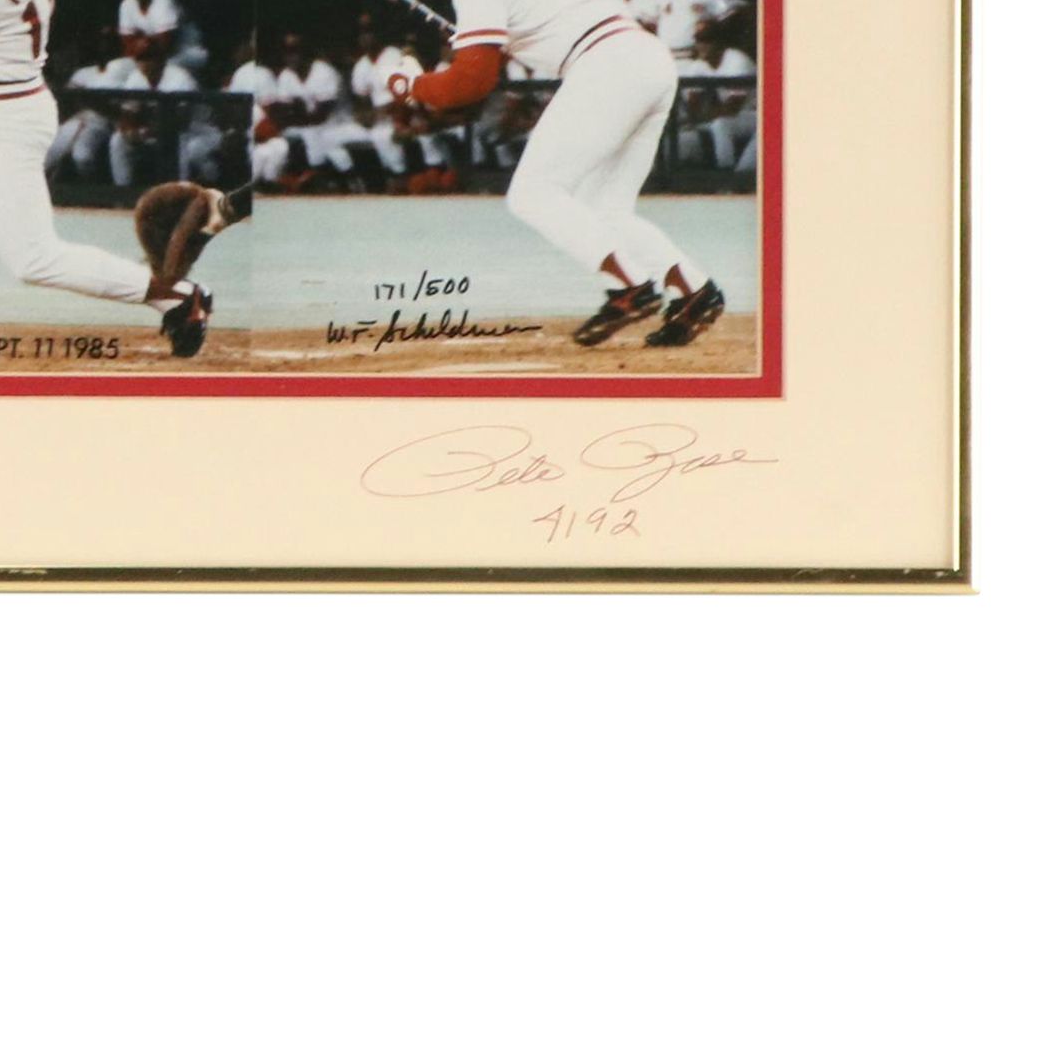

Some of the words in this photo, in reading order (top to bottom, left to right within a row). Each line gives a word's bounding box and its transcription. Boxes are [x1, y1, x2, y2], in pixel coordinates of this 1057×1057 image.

[375, 270, 470, 301] 171/500
[34, 338, 55, 358] 11
[64, 338, 120, 360] 1985
[360, 425, 566, 498] Pete
[532, 504, 641, 543] 4192
